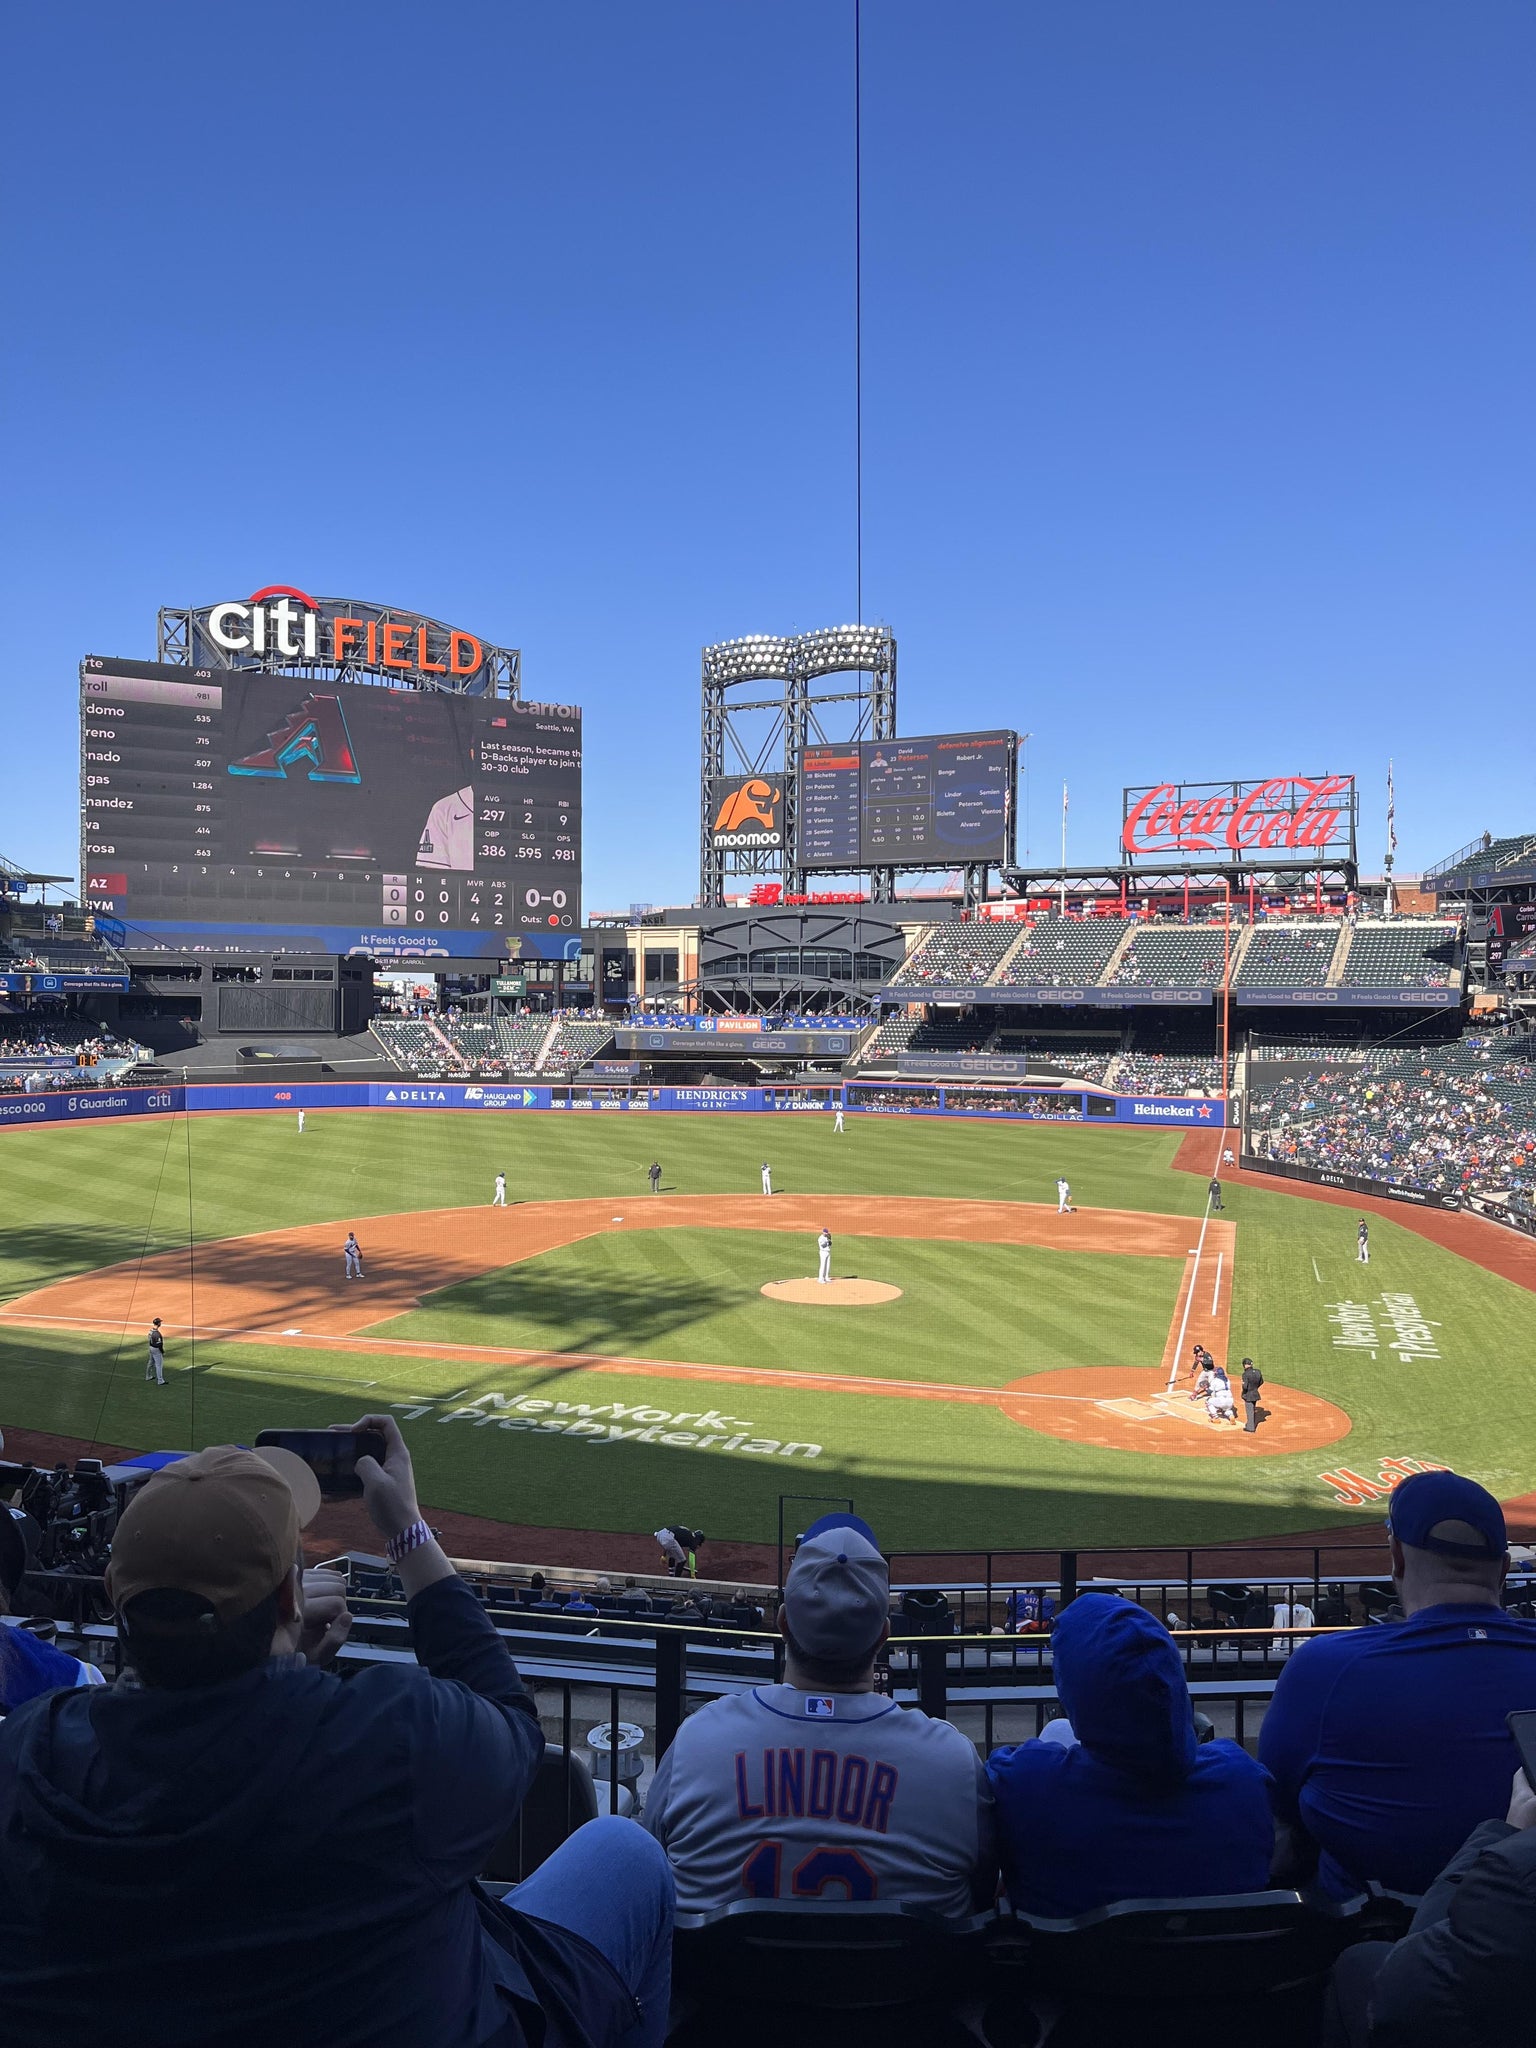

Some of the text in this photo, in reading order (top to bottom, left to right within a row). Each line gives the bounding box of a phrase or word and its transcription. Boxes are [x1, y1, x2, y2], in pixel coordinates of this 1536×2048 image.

[209, 599, 482, 674] citi FIELD
[85, 681, 108, 692] roll
[87, 704, 125, 717] domo
[512, 700, 580, 719] Carroll
[536, 723, 561, 732] Seattle,
[481, 741, 500, 750] Last
[502, 744, 534, 754] season,
[536, 746, 570, 757] became
[85, 752, 121, 762] nado
[481, 752, 518, 763] D-Backs
[520, 756, 547, 765] player
[560, 760, 575, 769] join
[481, 763, 529, 774] 30-30 club
[87, 775, 213, 790] gas 1.284
[86, 798, 133, 809] nandez
[479, 809, 568, 826] .297 2 9
[714, 832, 780, 847] moomoo
[87, 844, 115, 854] rosa
[478, 845, 575, 861] .386 .595 .981
[89, 878, 108, 889] AZ
[391, 888, 567, 908] 0 0 0 4 2 0-0
[784, 891, 864, 904] new balance
[391, 909, 542, 925] 0 0 0 4 2 Outs:
[361, 935, 438, 946] It Feels Good to
[932, 990, 976, 1000] GEICO
[1037, 990, 1084, 1000] GEICO
[1151, 990, 1202, 1000] GEICO
[1292, 992, 1338, 1001] GEICO
[1399, 993, 1449, 1001] GEICO
[752, 1041, 786, 1049] GEICO
[960, 1058, 1018, 1072] GEICO
[147, 1093, 171, 1108] citi
[274, 1092, 292, 1100] 408
[400, 1091, 446, 1100] DELTA
[676, 1090, 747, 1101] HENDRICK'S
[23, 1103, 46, 1113] QQQ
[80, 1098, 128, 1109] Guardian
[550, 1100, 566, 1108] 380
[572, 1100, 593, 1108] GOYA
[600, 1100, 621, 1108] GOYA
[628, 1100, 649, 1108] GOYA
[831, 1101, 843, 1109] 370
[865, 1106, 912, 1114] CADILLAC
[1134, 1103, 1195, 1117] Heineken
[468, 1391, 754, 1430] NewYork-
[437, 1406, 824, 1458] Presbyterian
[735, 1747, 898, 1834] LINDOR
